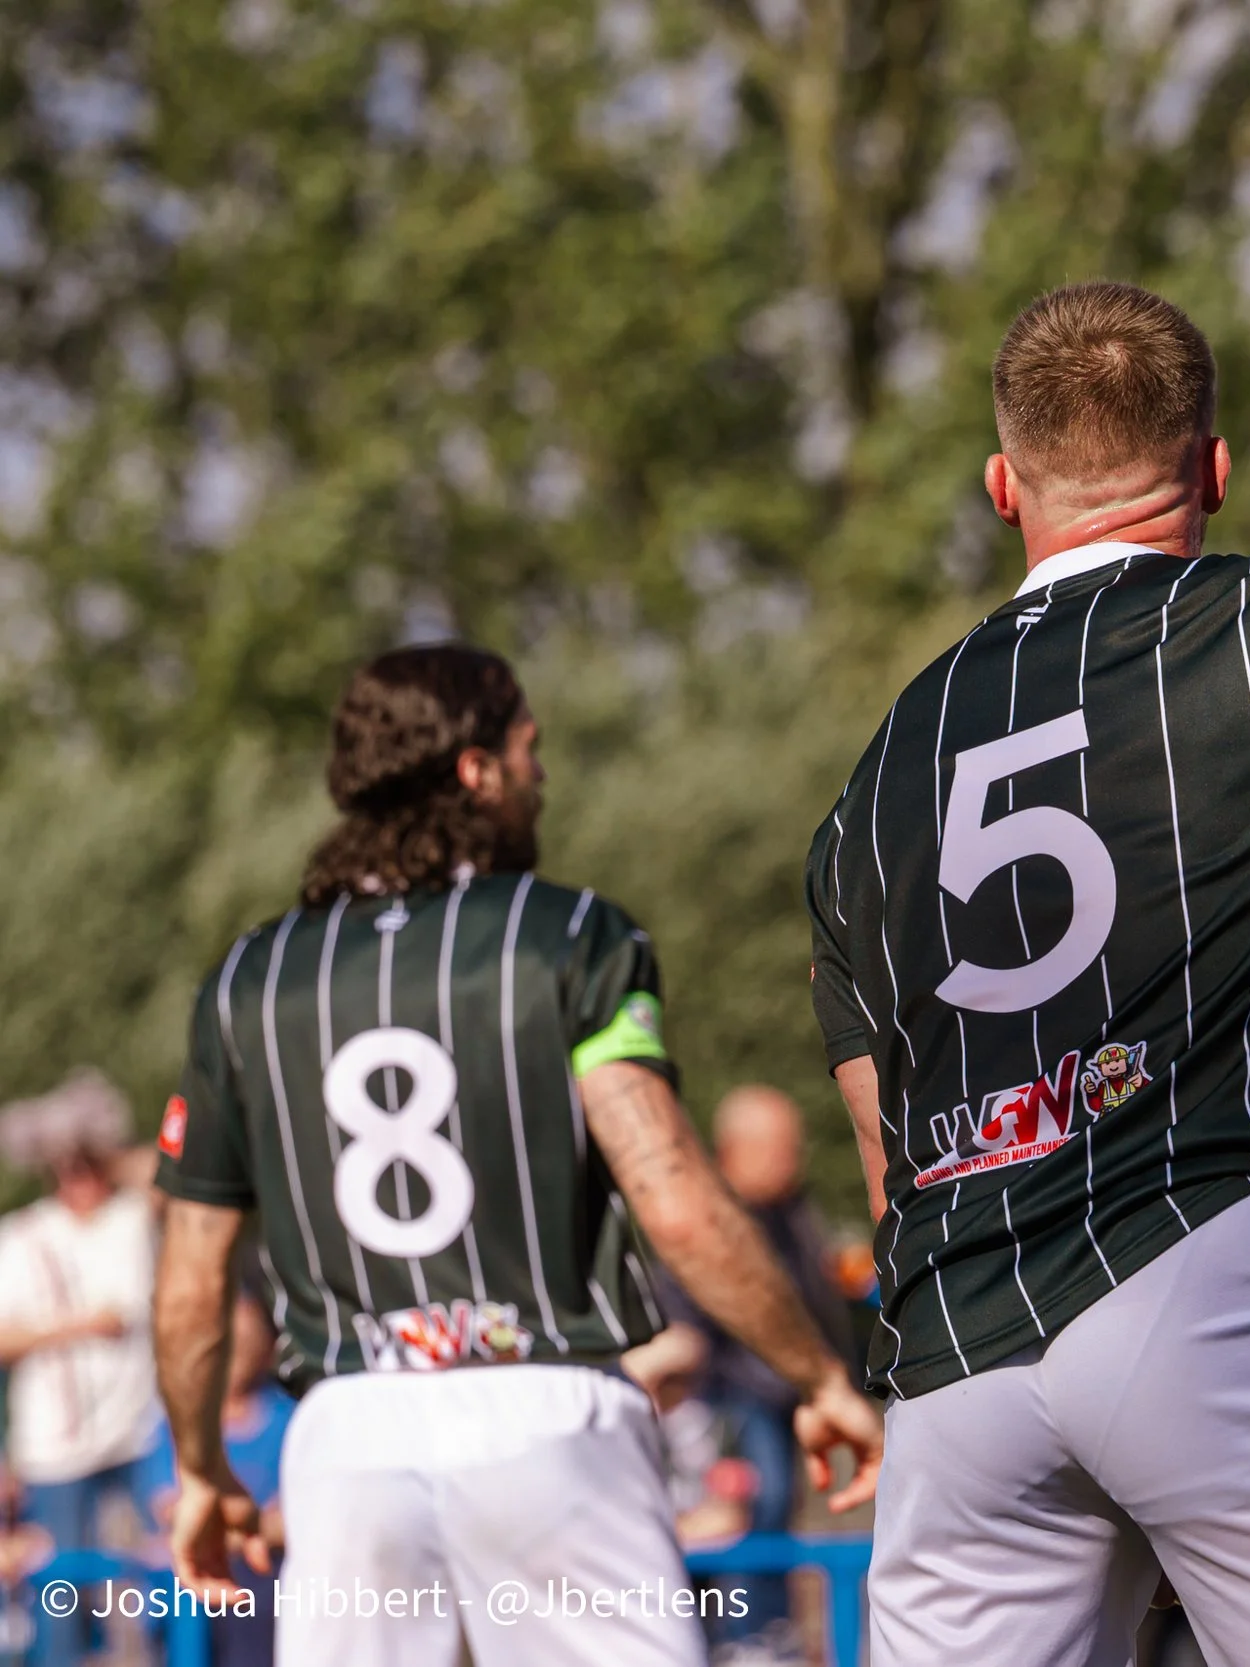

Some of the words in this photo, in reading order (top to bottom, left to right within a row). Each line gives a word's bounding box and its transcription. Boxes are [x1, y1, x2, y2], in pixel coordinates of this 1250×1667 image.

[934, 708, 1117, 1014] 5
[323, 1026, 476, 1258] 8
[916, 1166, 954, 1188] BUILDING
[954, 1162, 972, 1175] AND
[973, 1152, 1010, 1171] PLANNED
